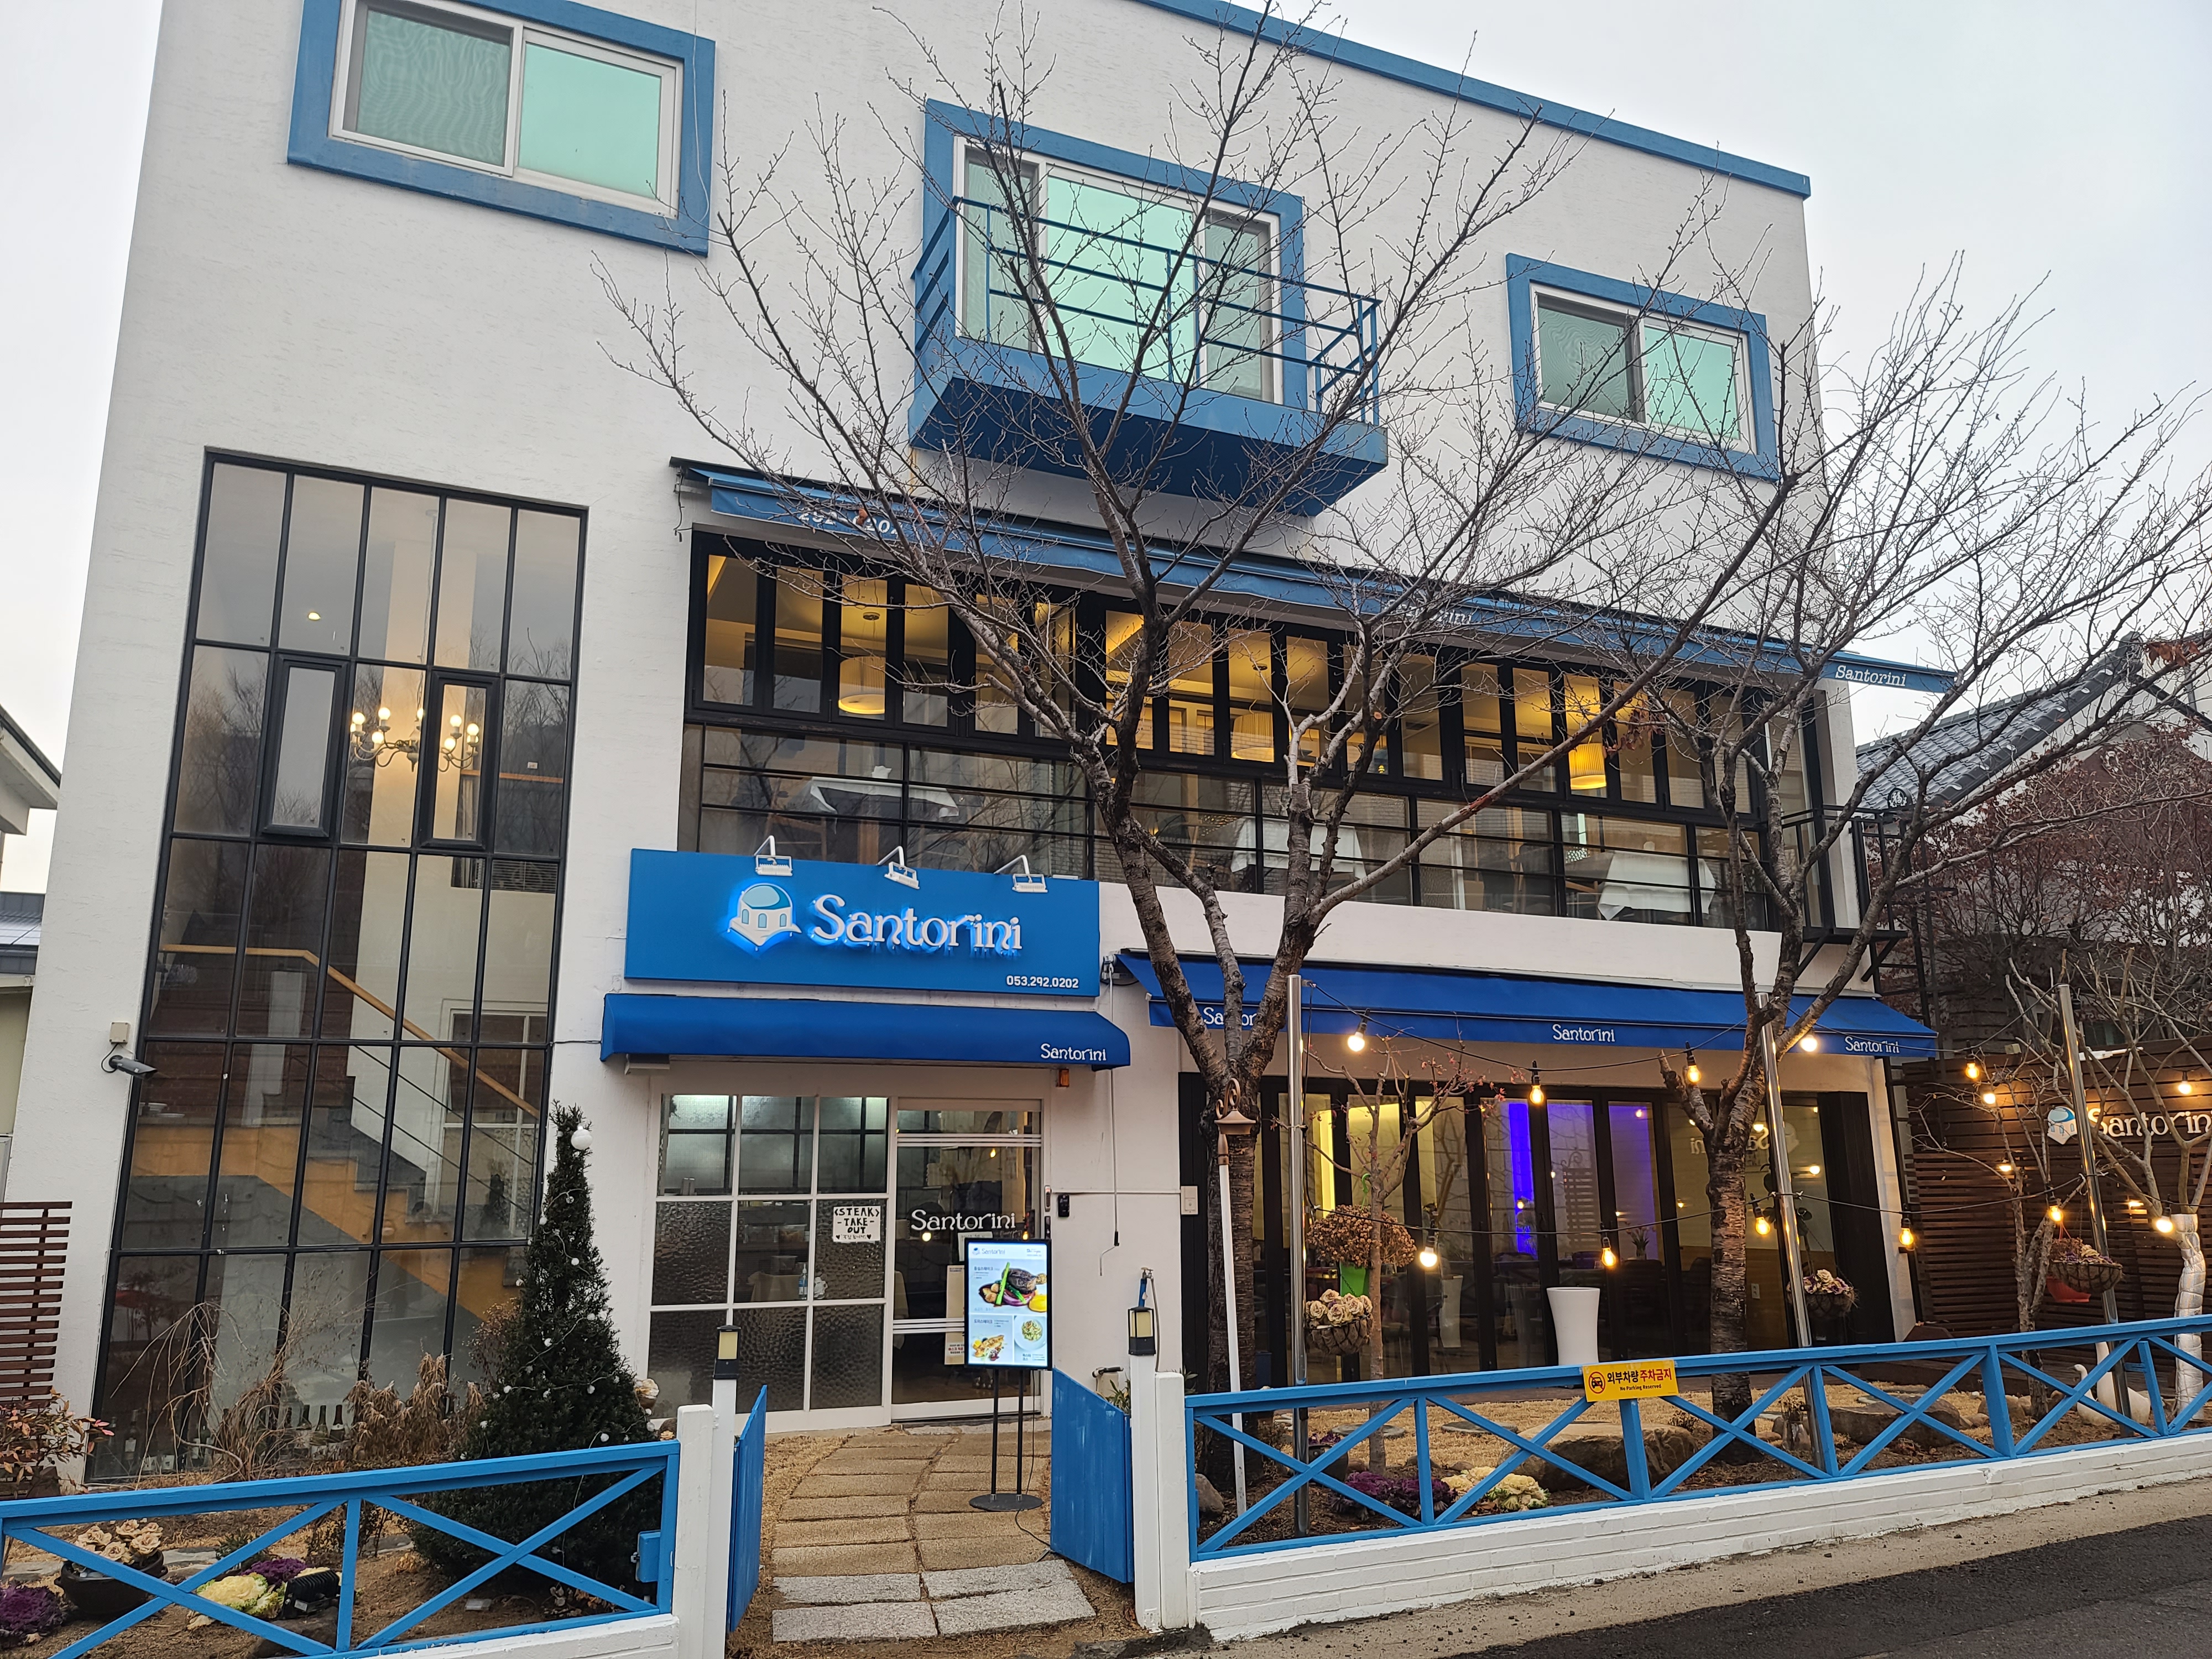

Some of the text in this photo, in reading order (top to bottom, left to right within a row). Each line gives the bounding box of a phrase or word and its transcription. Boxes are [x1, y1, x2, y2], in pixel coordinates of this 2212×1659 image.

[1835, 665, 1907, 686] Santorini
[813, 894, 1022, 950] Santorini
[1006, 975, 1079, 988] 053.292.0202
[1552, 1024, 1615, 1042] Santorini
[1040, 1043, 1107, 1061] Santorini
[1845, 1036, 1900, 1053] Santorini
[2086, 1108, 2212, 1137] Santorin
[911, 1209, 1016, 1230] Santorini
[1607, 1368, 1672, 1384] 외부차량 주차금지
